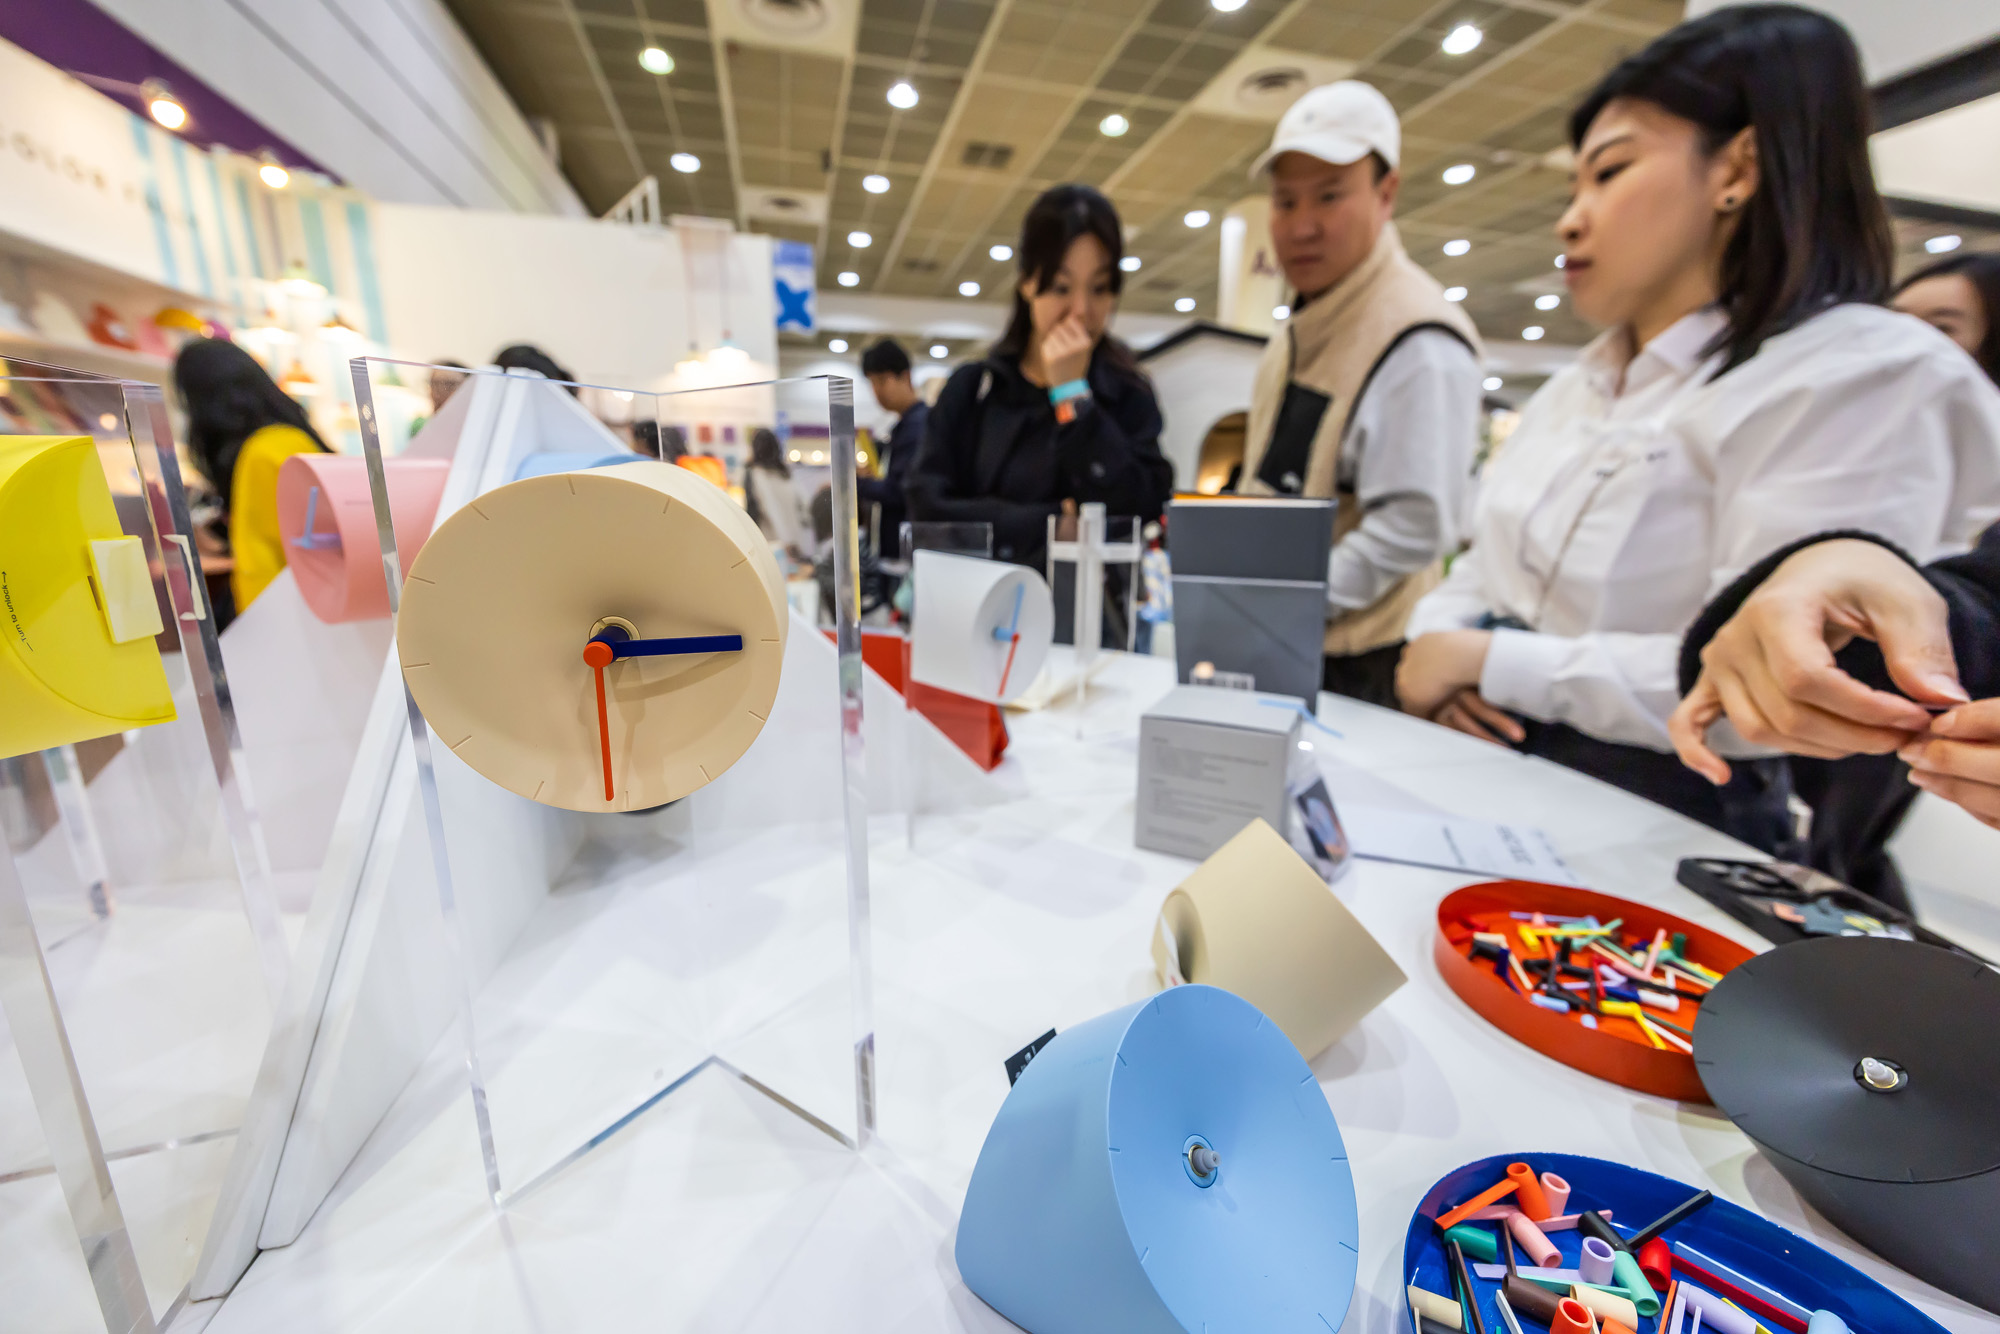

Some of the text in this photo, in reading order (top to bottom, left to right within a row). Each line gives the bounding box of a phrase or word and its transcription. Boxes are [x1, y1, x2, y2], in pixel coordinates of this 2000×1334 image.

[0, 118, 109, 195] OLOR
[2, 584, 27, 642] Turn to unlock
